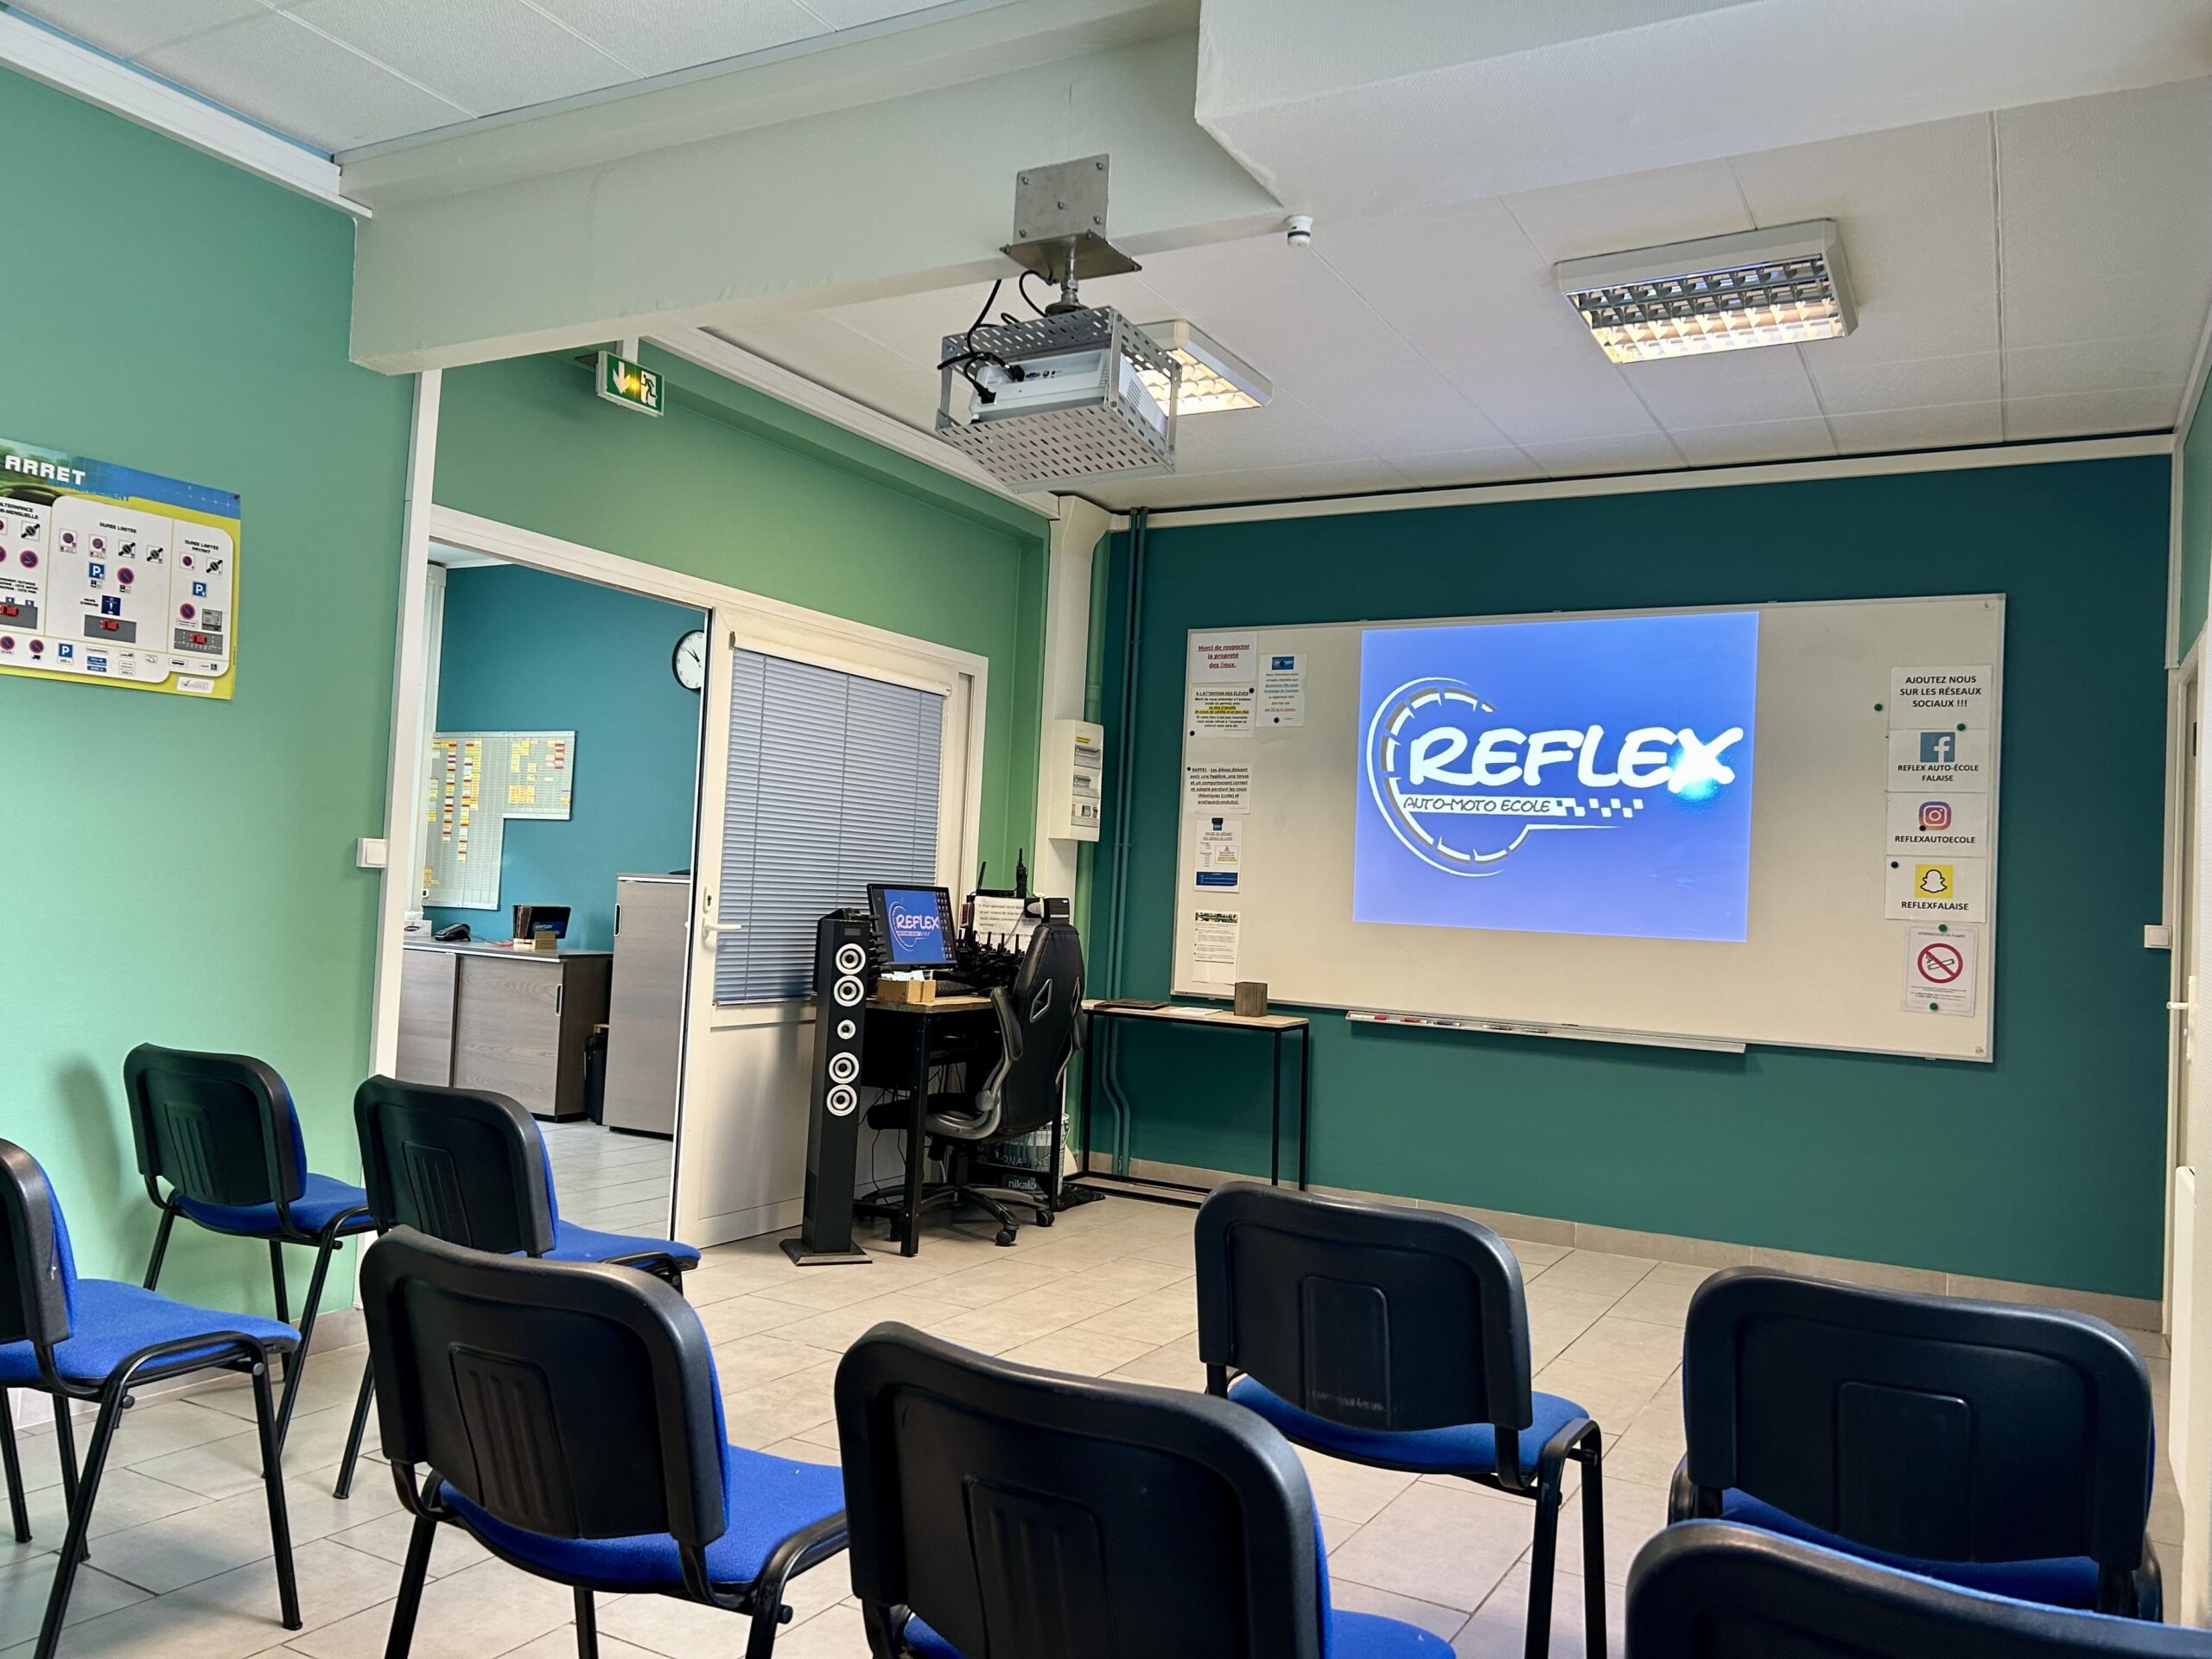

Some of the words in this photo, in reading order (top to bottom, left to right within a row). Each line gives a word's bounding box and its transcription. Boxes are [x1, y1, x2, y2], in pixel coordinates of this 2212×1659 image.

[4, 454, 86, 486] ARRET
[1939, 686, 1981, 695] RÉSEAUX
[1409, 723, 1744, 794] REFLEX
[1928, 763, 1980, 772] AUTO-ÉCOLE
[1403, 797, 1497, 812] AUTO-MOTO
[1501, 798, 1552, 813] ECOLE
[1901, 901, 1969, 911] REFLEXFALAISE
[896, 914, 940, 930] REFLEX
